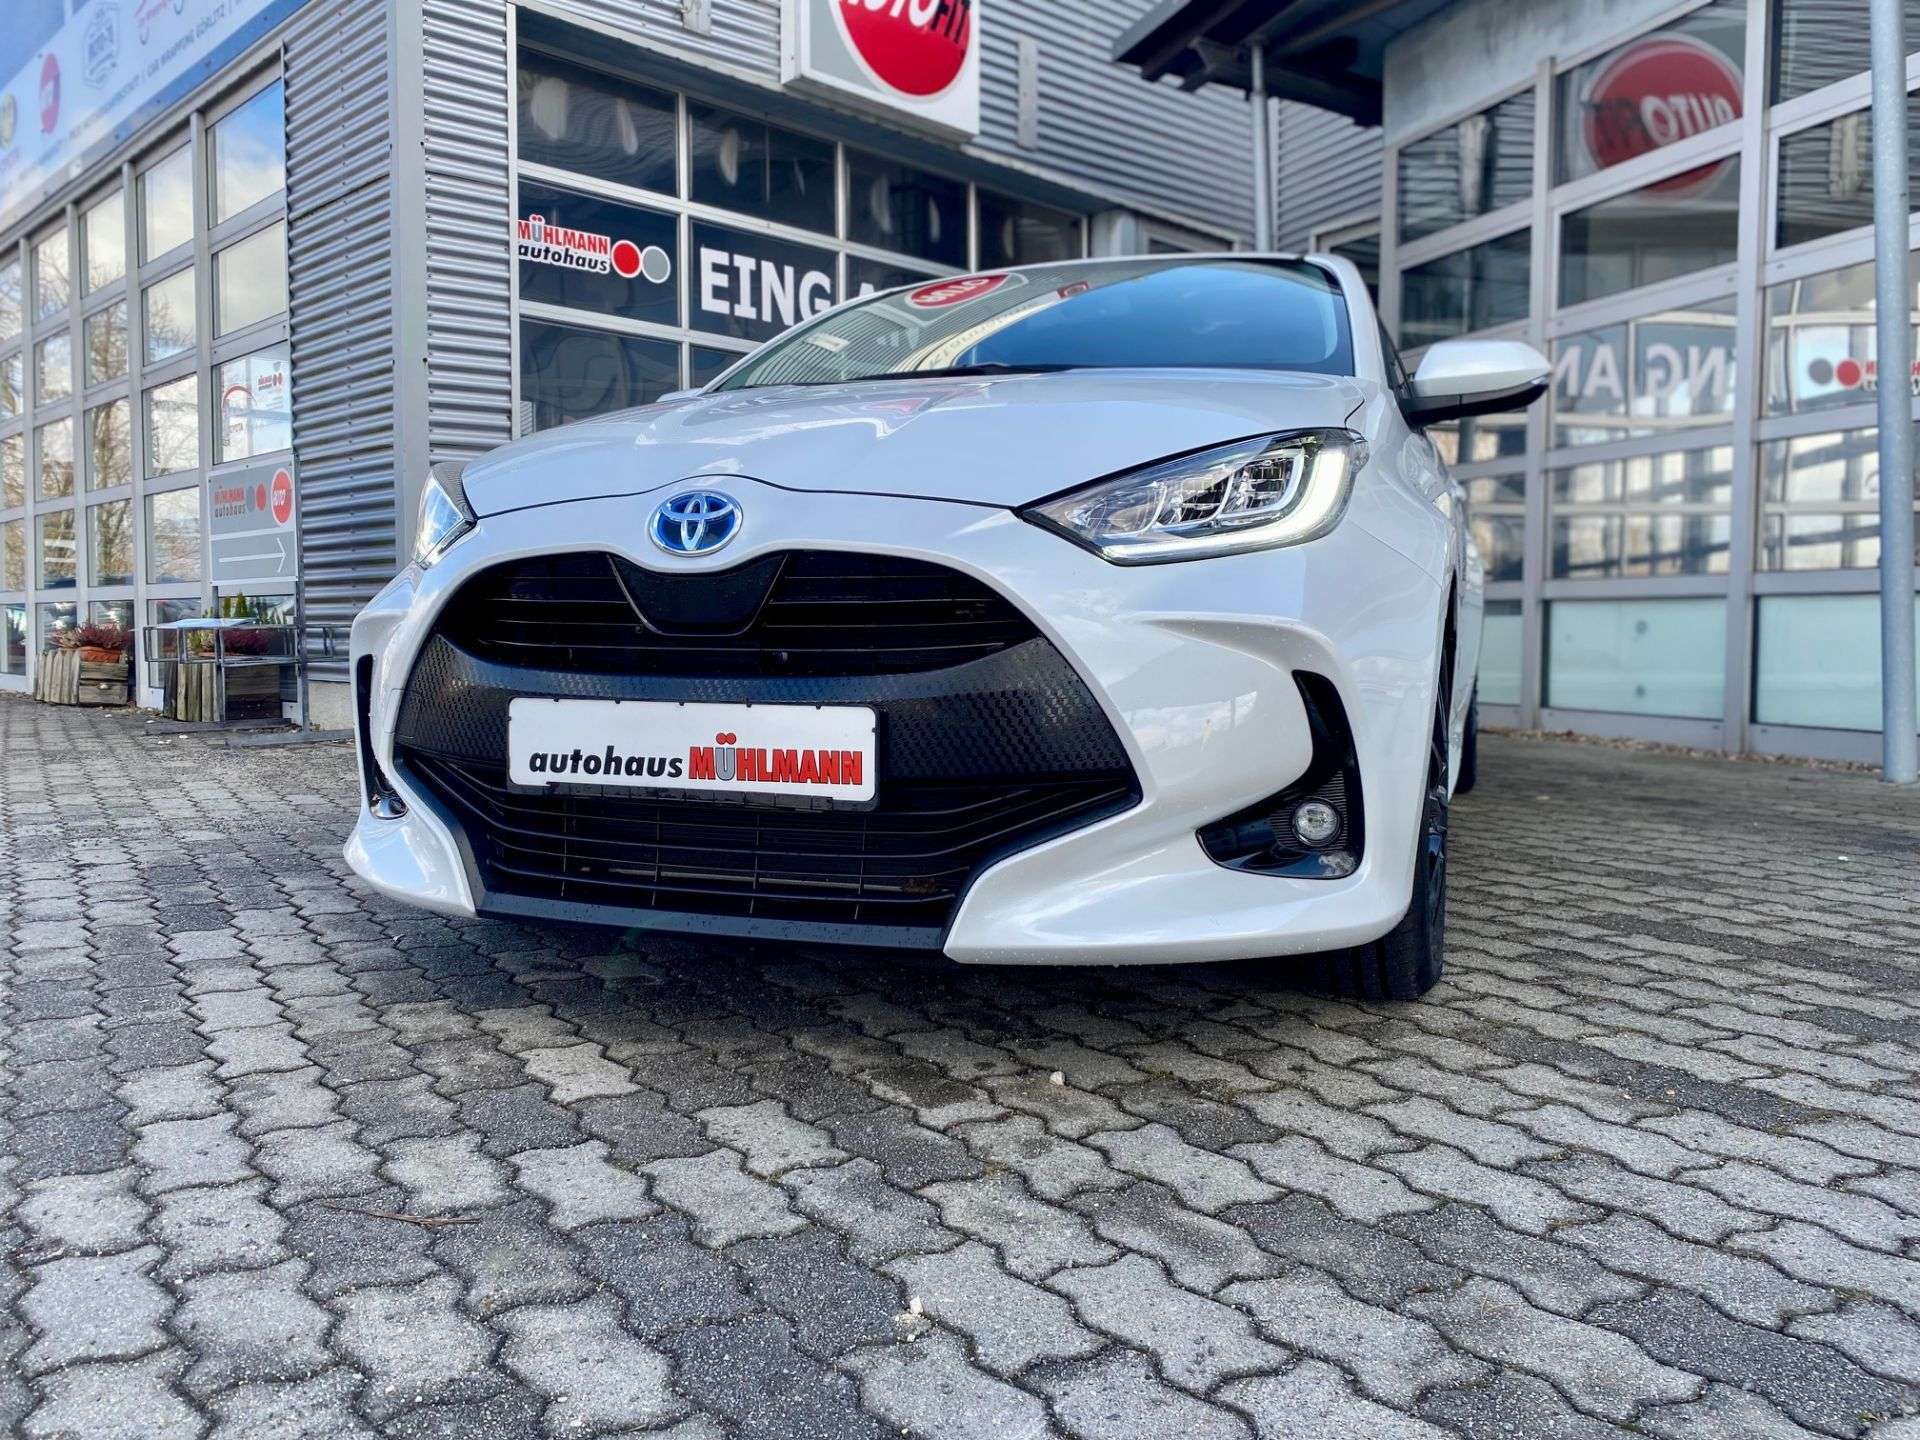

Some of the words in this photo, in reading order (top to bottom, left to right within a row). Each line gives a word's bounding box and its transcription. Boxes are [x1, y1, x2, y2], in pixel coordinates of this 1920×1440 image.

[518, 214, 608, 255] MÜHLMANN
[518, 244, 609, 272] autohaus
[701, 246, 876, 327] EING
[529, 745, 684, 779] autohaus
[688, 732, 863, 786] MÜHLMANN
